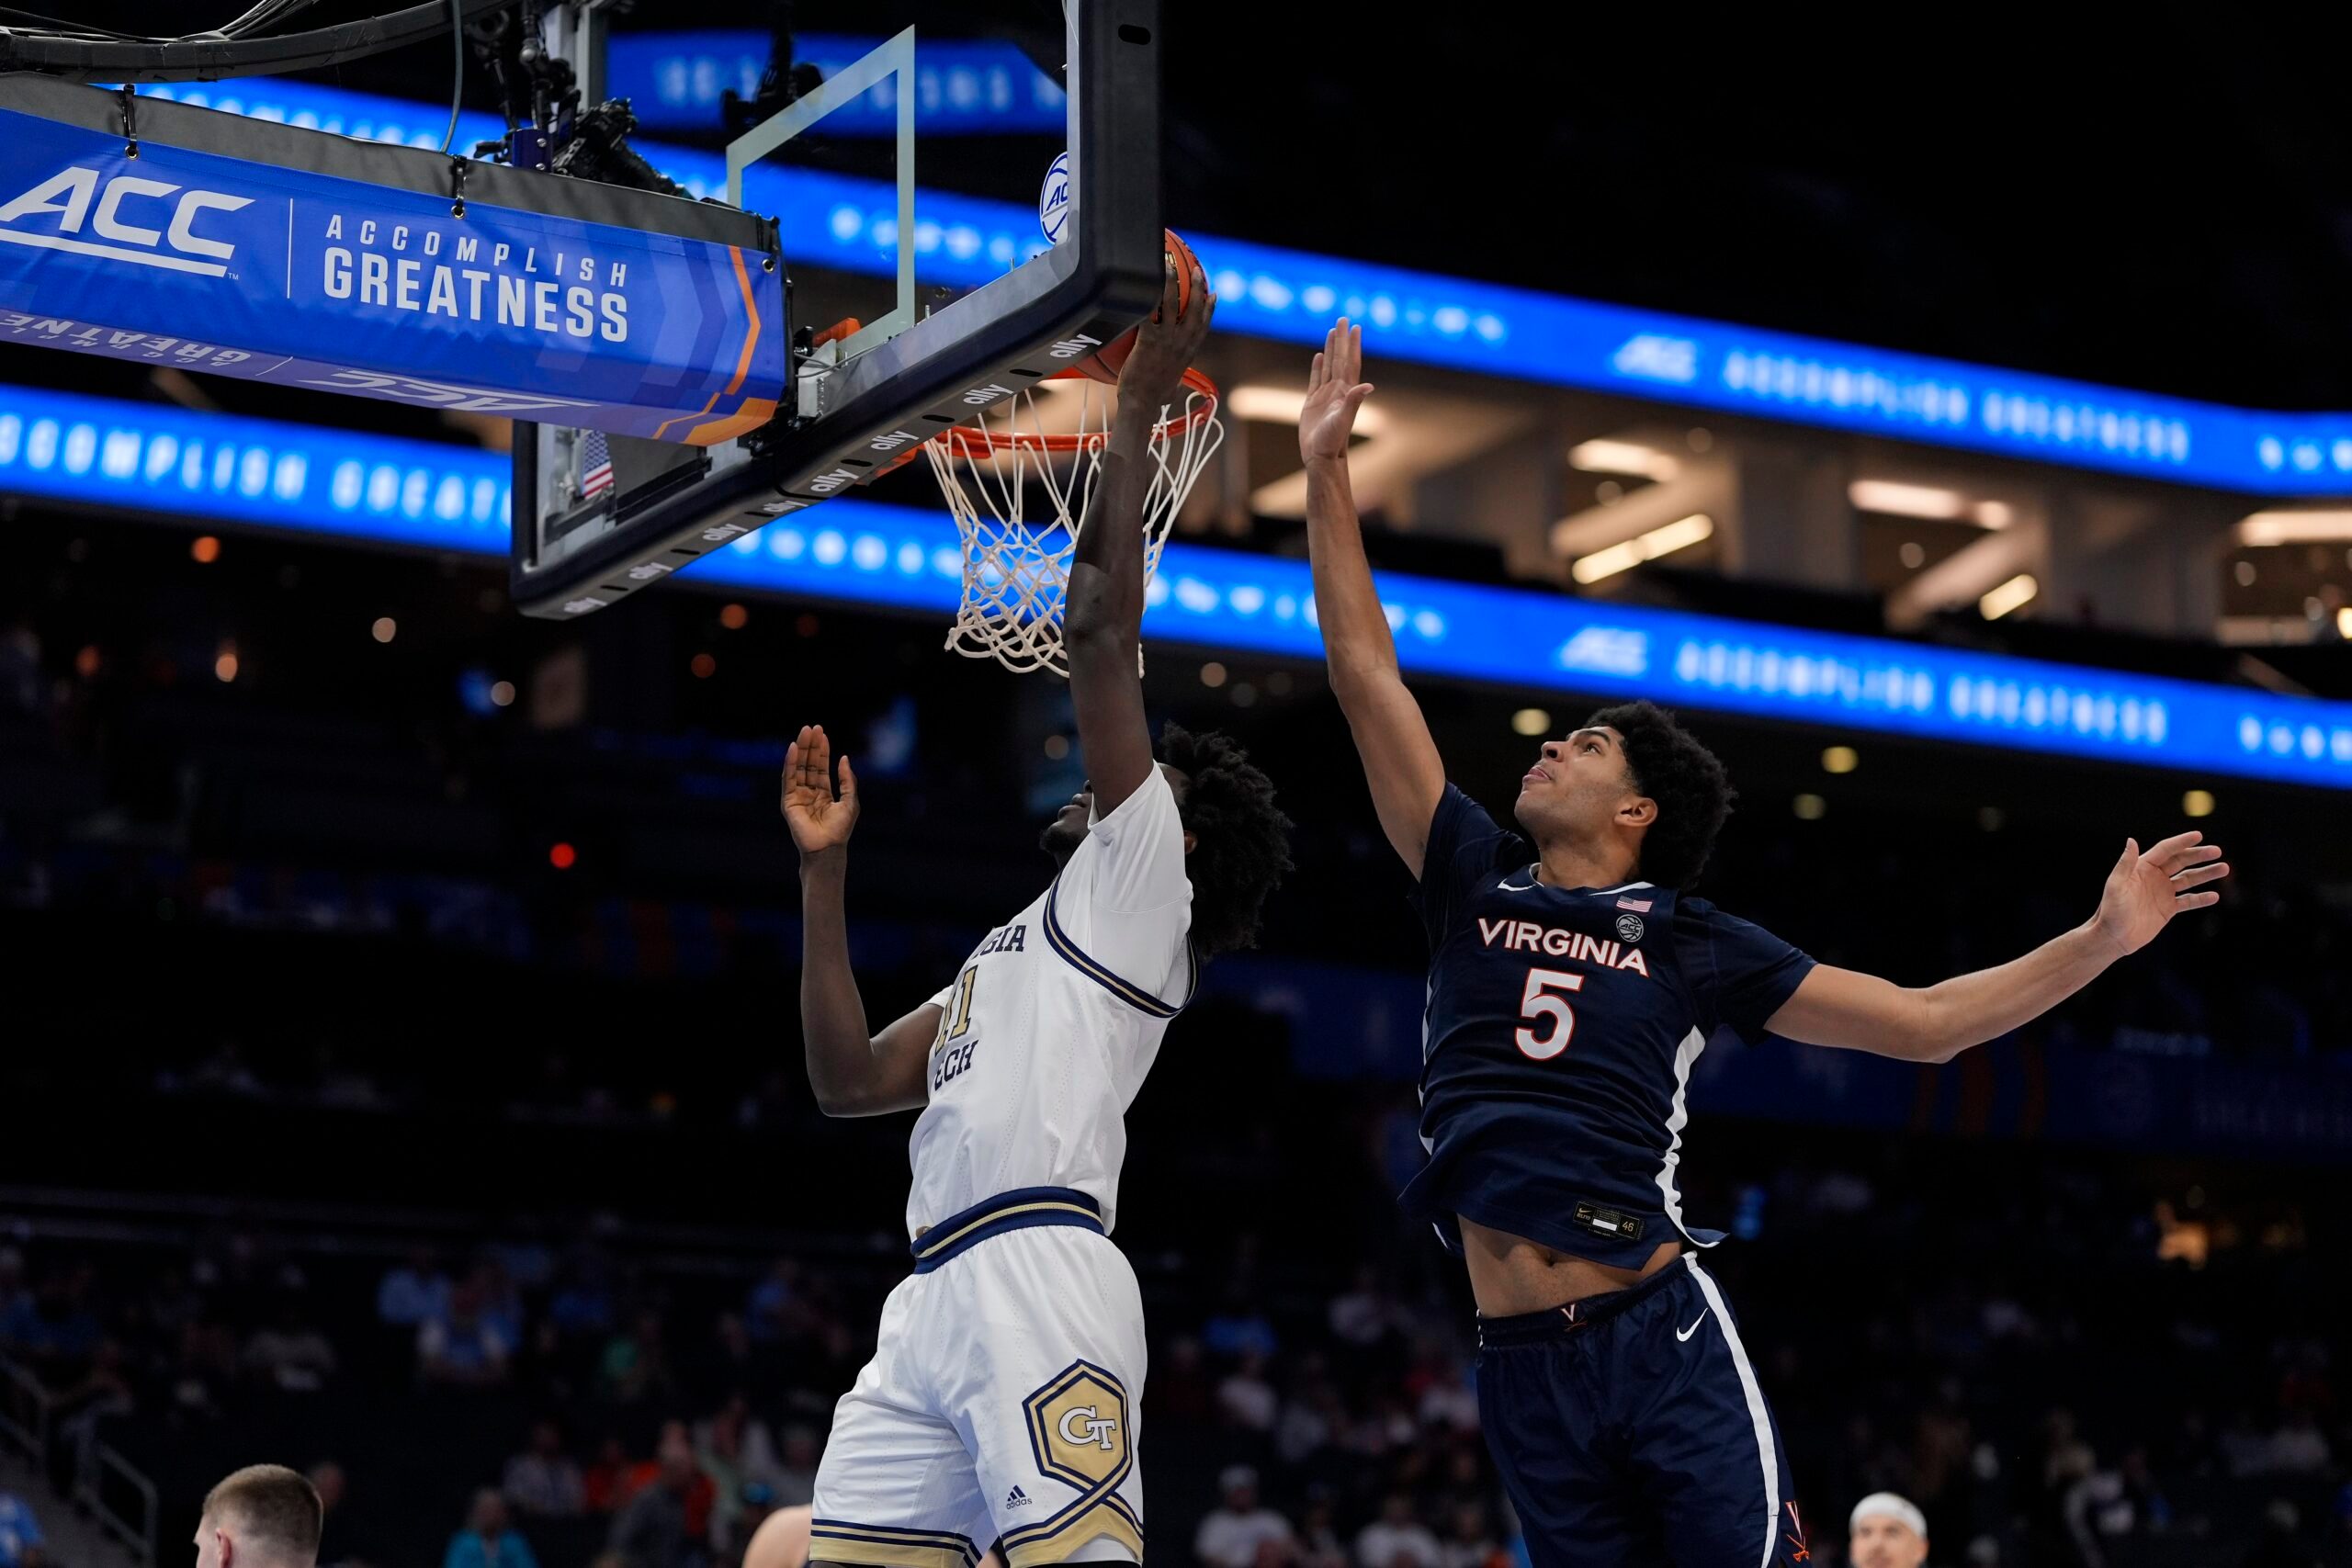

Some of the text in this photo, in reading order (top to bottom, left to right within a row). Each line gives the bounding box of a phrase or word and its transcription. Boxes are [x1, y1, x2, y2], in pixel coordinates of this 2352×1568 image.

[0, 166, 256, 260] ACC
[325, 214, 627, 288] ACCOMPLISH
[323, 246, 628, 343] GREATNESS
[1049, 333, 1102, 359] ally
[963, 383, 1014, 405] ally
[870, 430, 920, 451] ally
[809, 468, 859, 492] ally
[702, 523, 749, 542] ally
[1477, 918, 1649, 978] VIRGINIA
[1516, 967, 1585, 1062] 5
[1622, 1220, 1635, 1233] 46
[1057, 1405, 1117, 1450] GT
[1006, 1496, 1033, 1510] adidas
